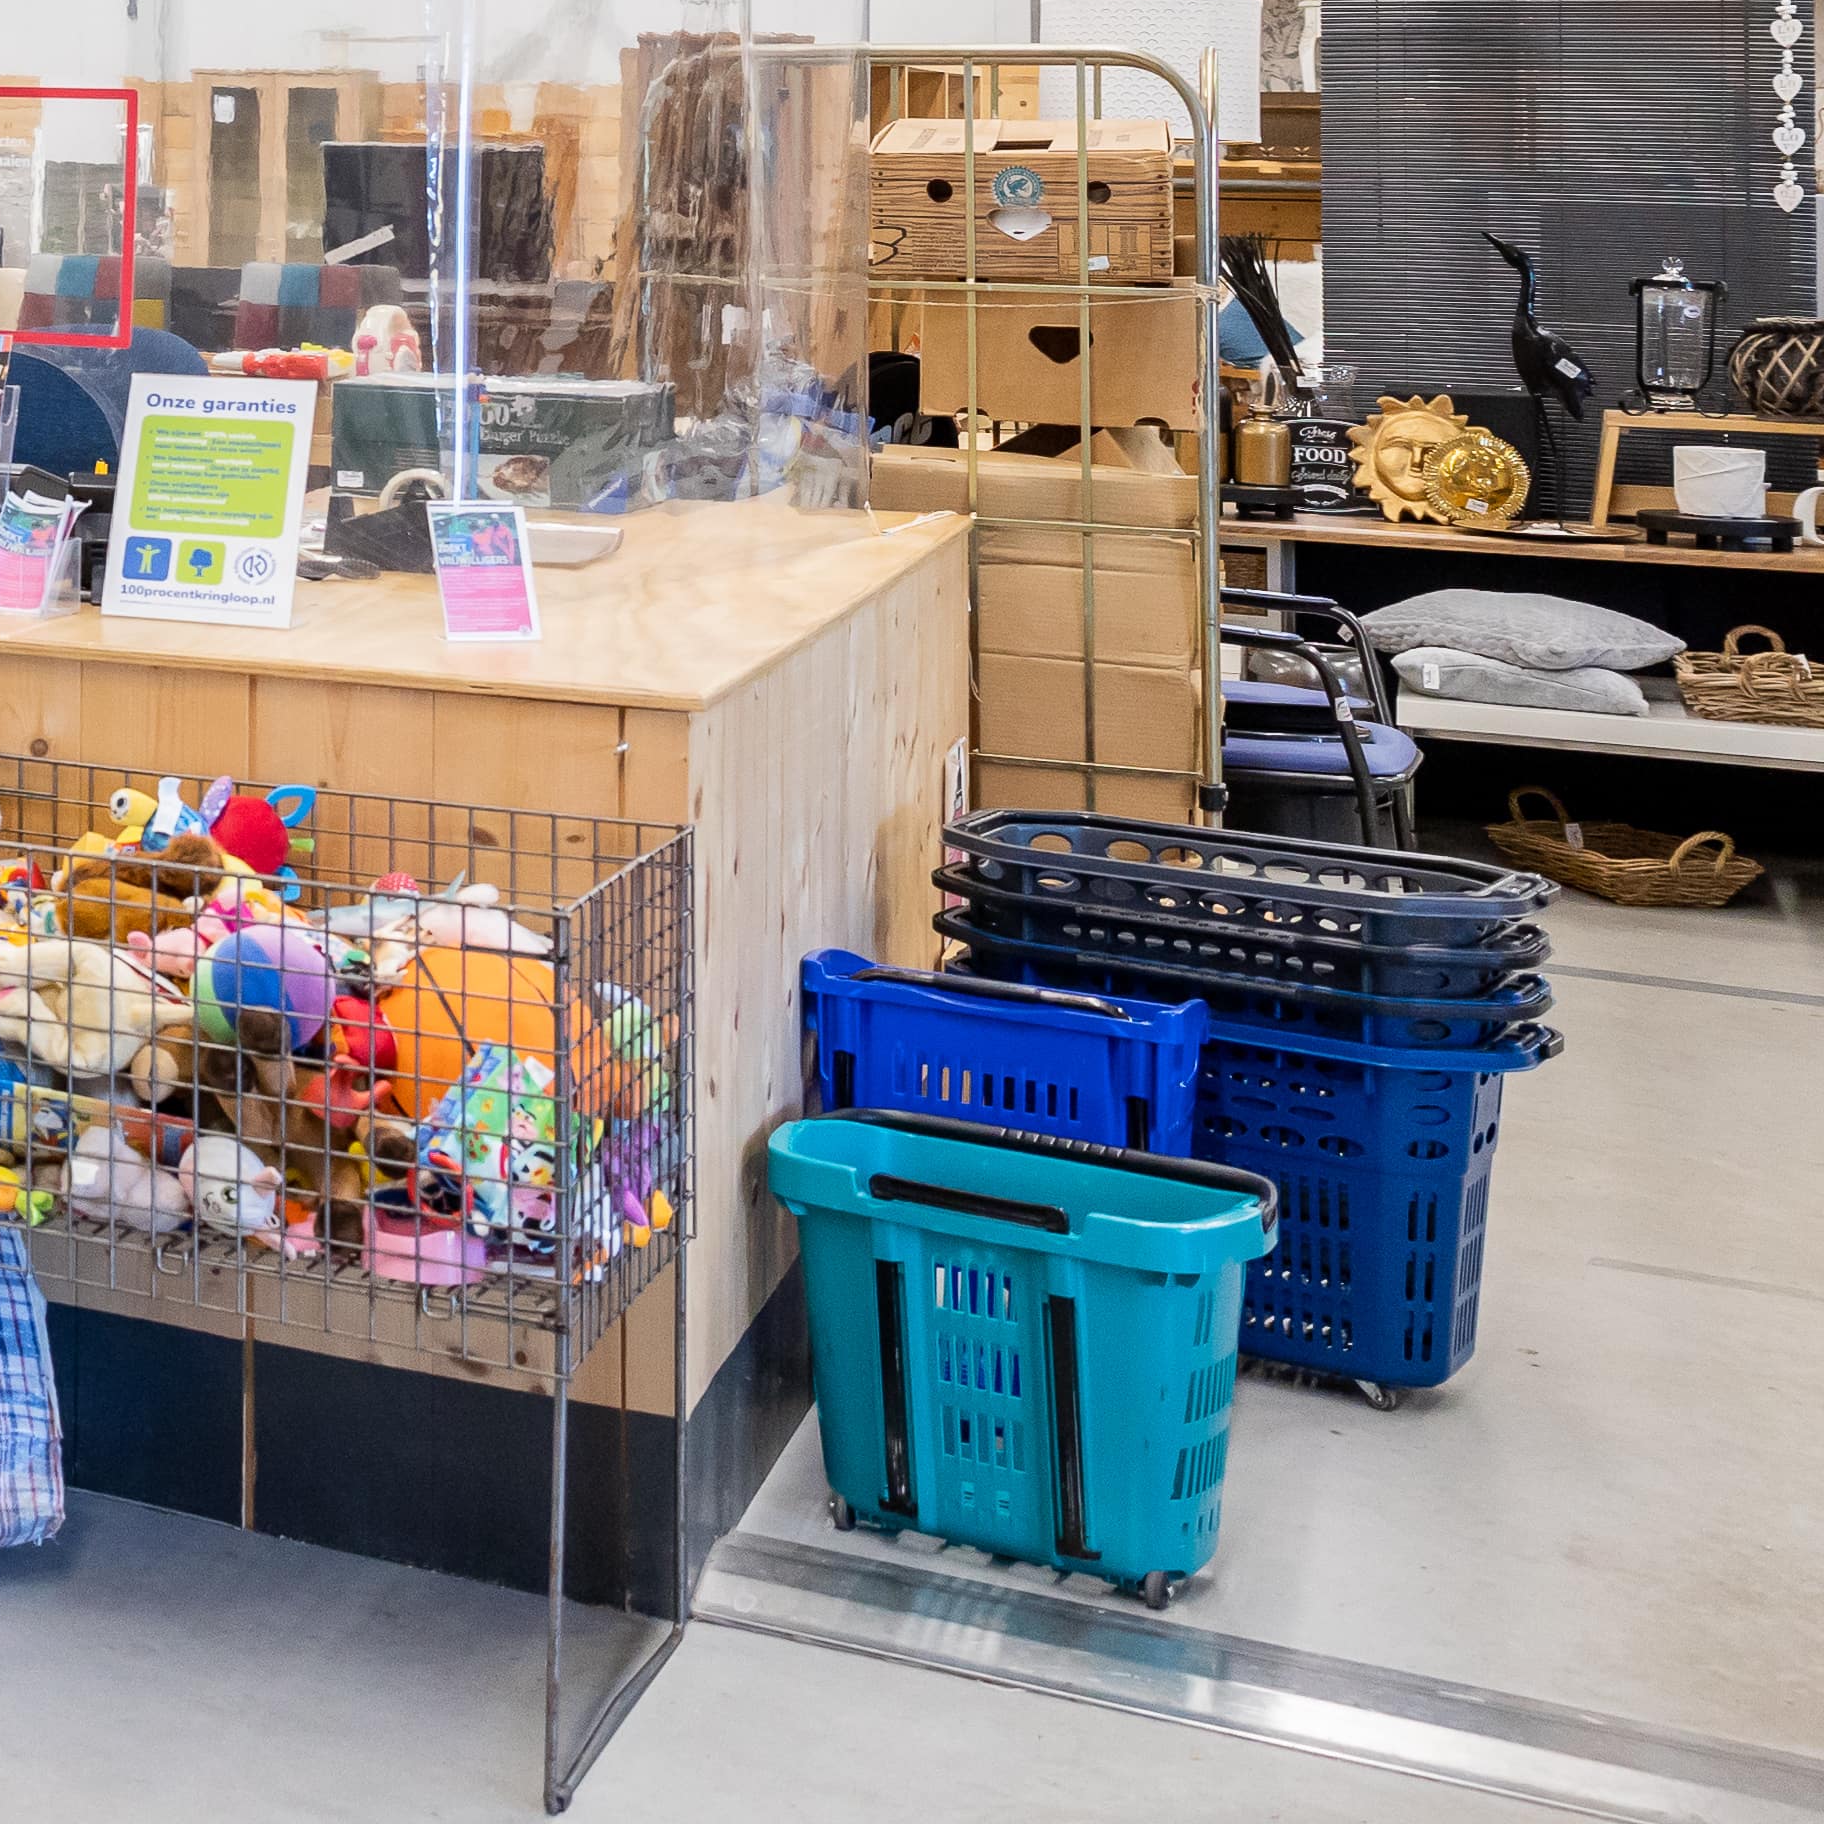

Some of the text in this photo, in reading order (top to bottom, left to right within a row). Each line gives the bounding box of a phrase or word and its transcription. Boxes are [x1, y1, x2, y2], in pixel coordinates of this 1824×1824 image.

[146, 393, 297, 414] Onze garanties
[1294, 447, 1346, 464] FOOD
[120, 584, 276, 606] 100procentkringloop.nl
